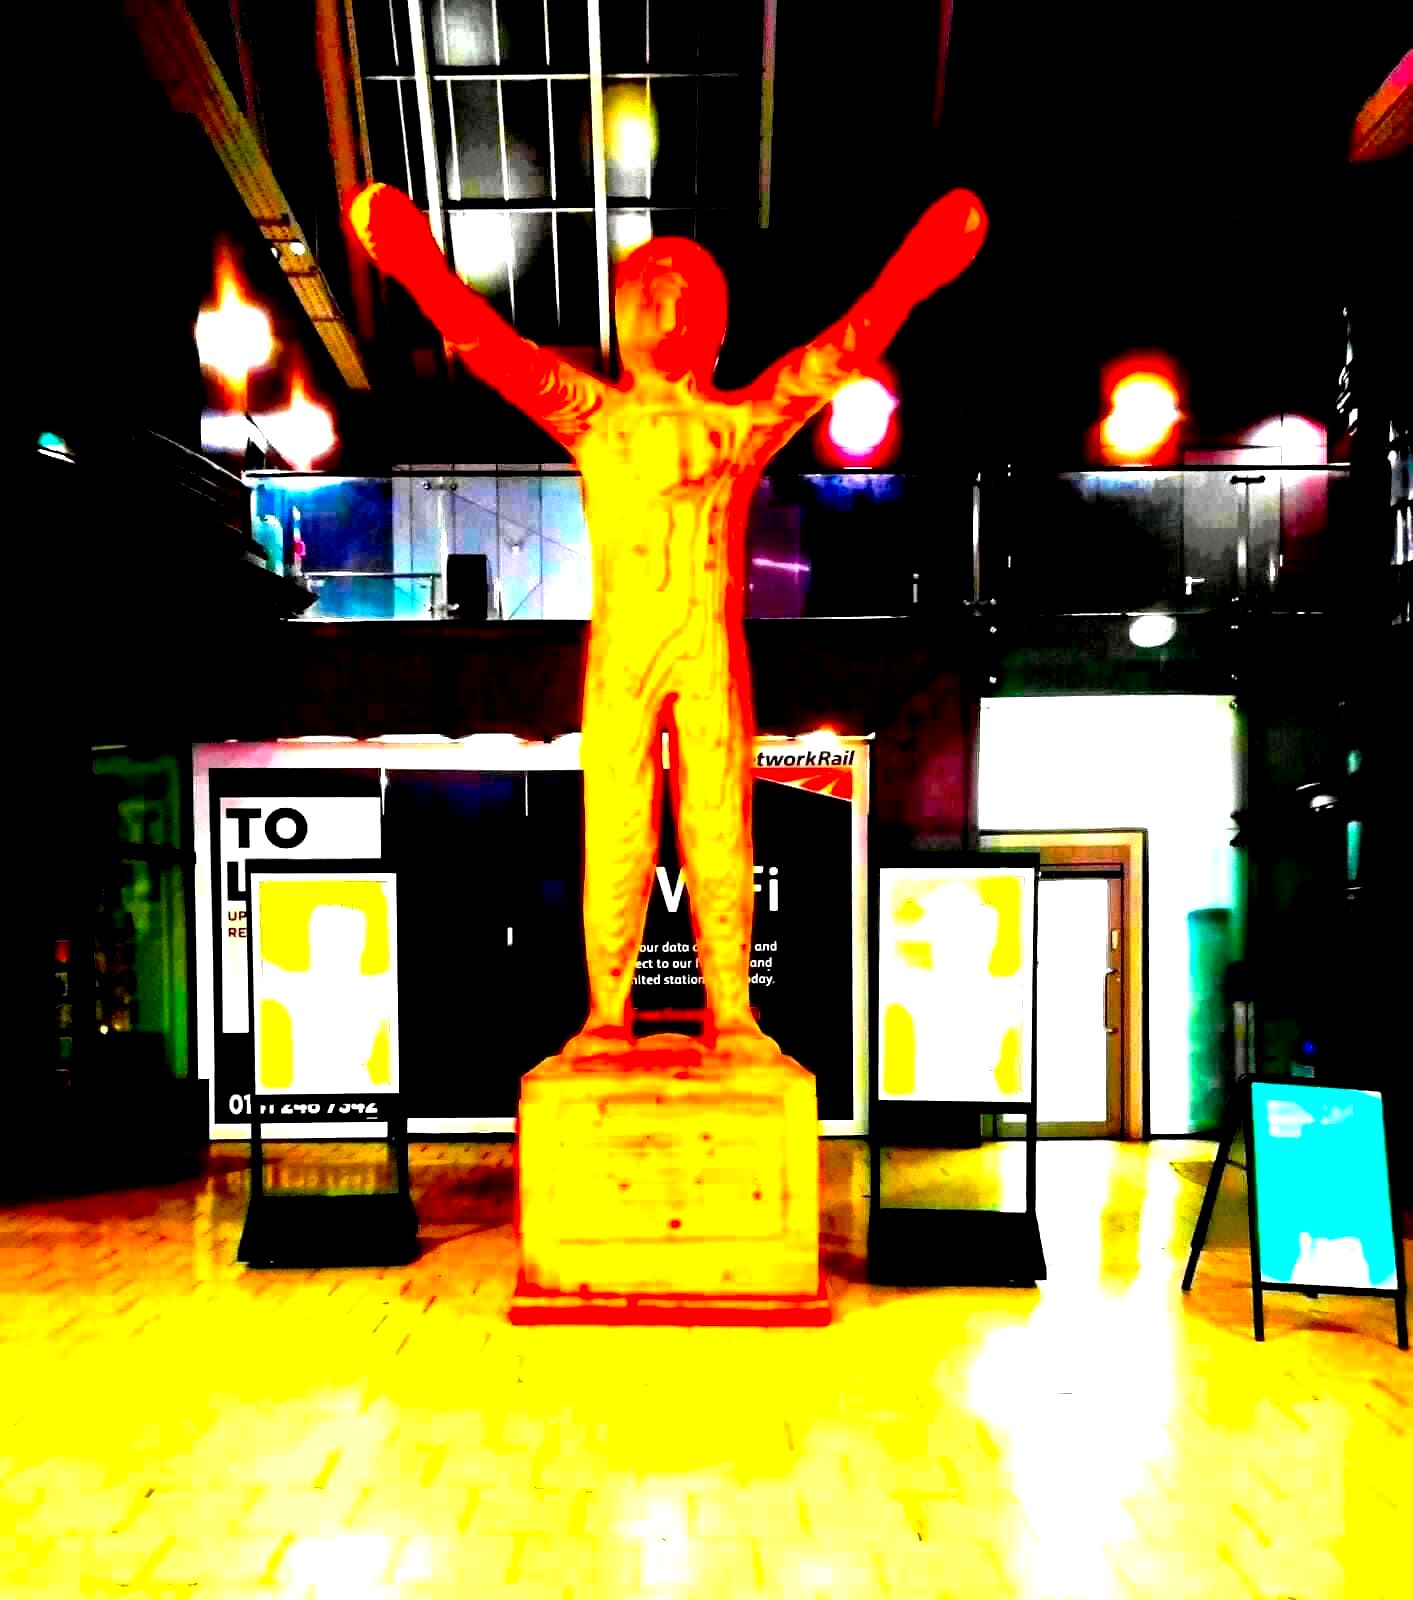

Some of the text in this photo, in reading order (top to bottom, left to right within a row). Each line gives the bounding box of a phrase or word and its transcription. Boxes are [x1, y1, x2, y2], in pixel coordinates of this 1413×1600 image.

[754, 750, 855, 766] tworkRail
[226, 808, 308, 849] TO
[662, 941, 690, 952] data
[755, 941, 777, 951] and
[657, 960, 669, 968] to
[673, 960, 692, 968] our
[750, 957, 772, 967] and
[749, 973, 775, 986] day.
